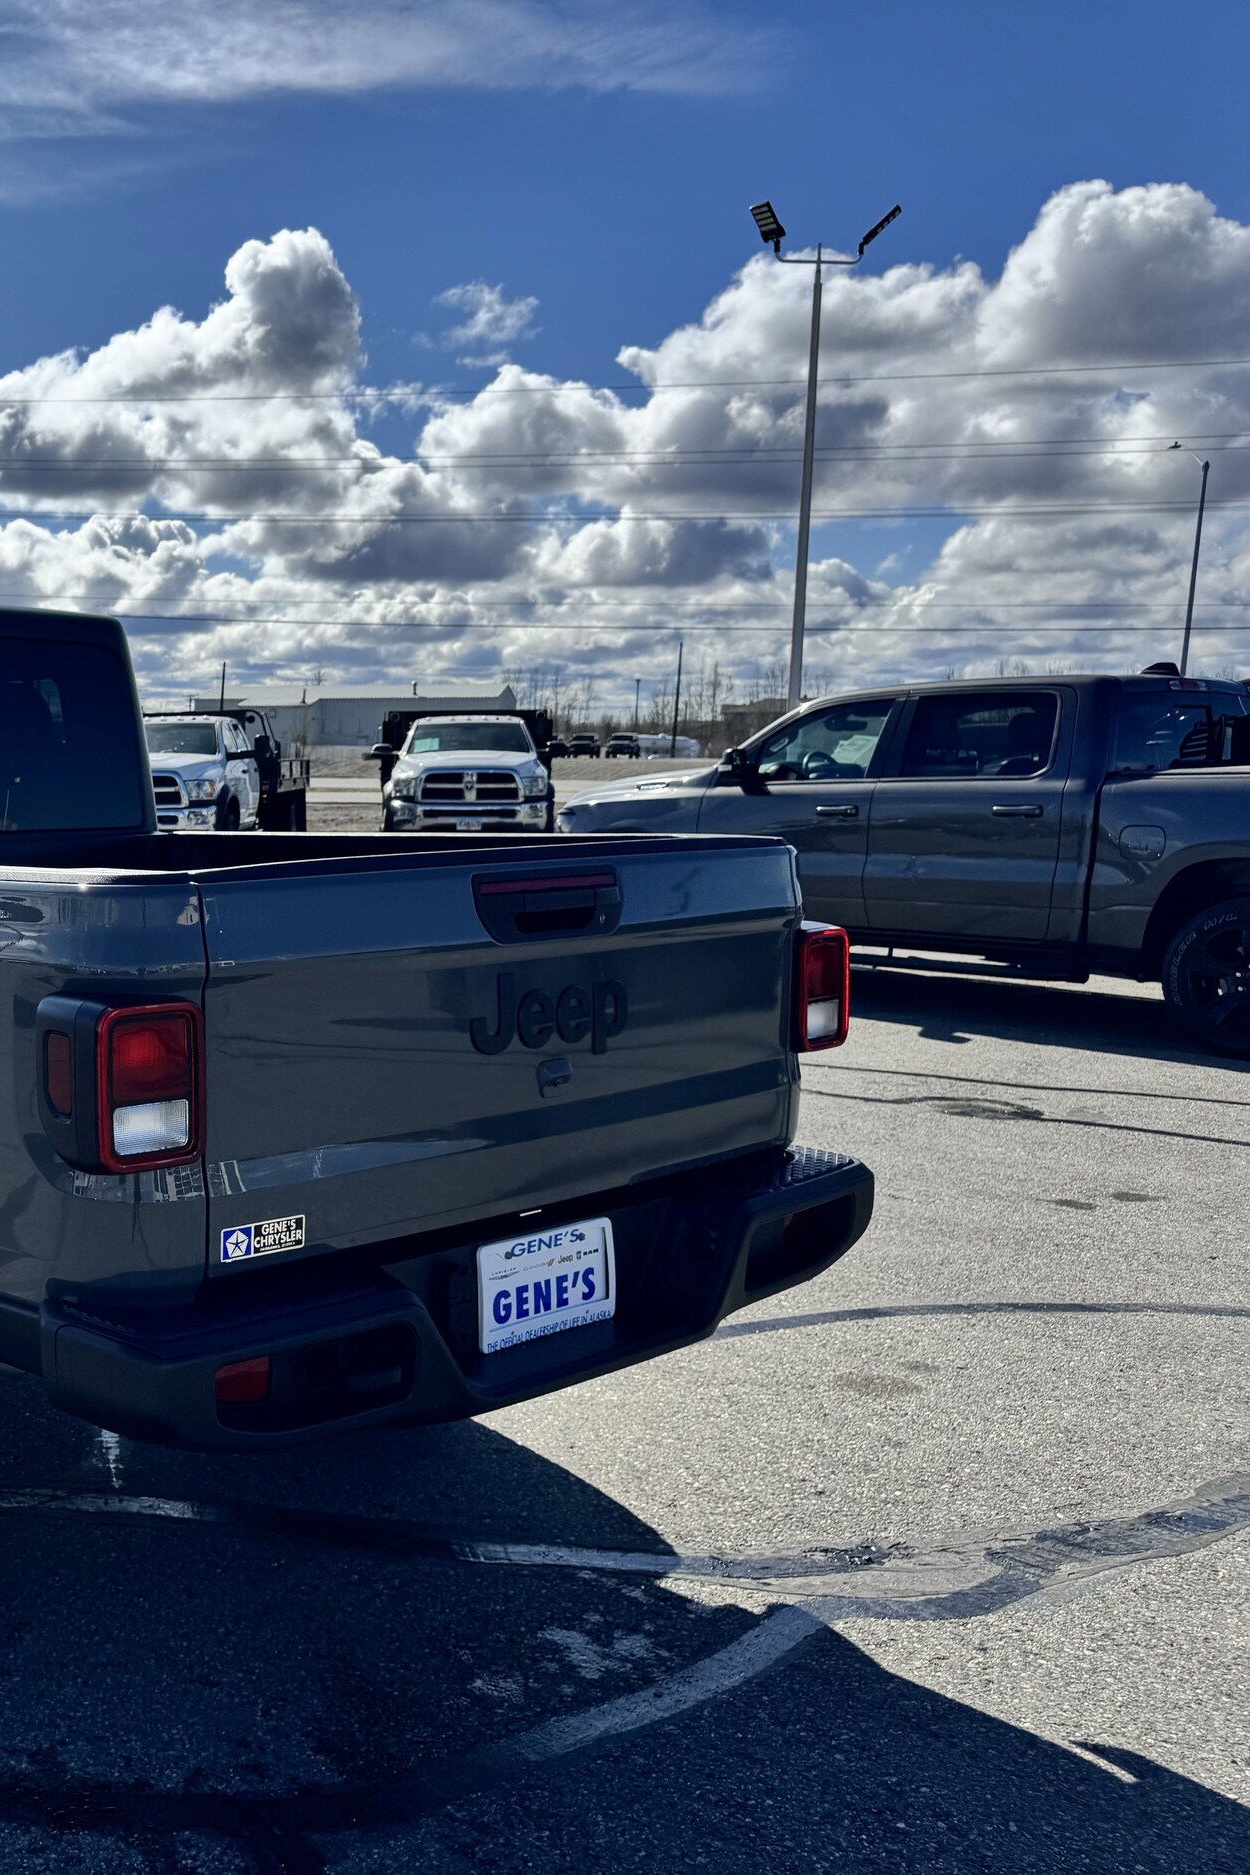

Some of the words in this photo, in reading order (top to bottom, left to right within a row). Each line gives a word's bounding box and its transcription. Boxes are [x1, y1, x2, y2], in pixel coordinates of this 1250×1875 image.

[469, 972, 629, 1056] Jeep
[254, 1229, 302, 1248] CHRYSLER
[262, 1219, 296, 1235] GENE'S
[510, 1228, 580, 1257] GENE'S
[557, 1254, 574, 1264] Jeep
[492, 1267, 596, 1325] GENE'S
[487, 1341, 498, 1353] THE
[559, 1319, 568, 1331] OF
[581, 1313, 588, 1325] IN
